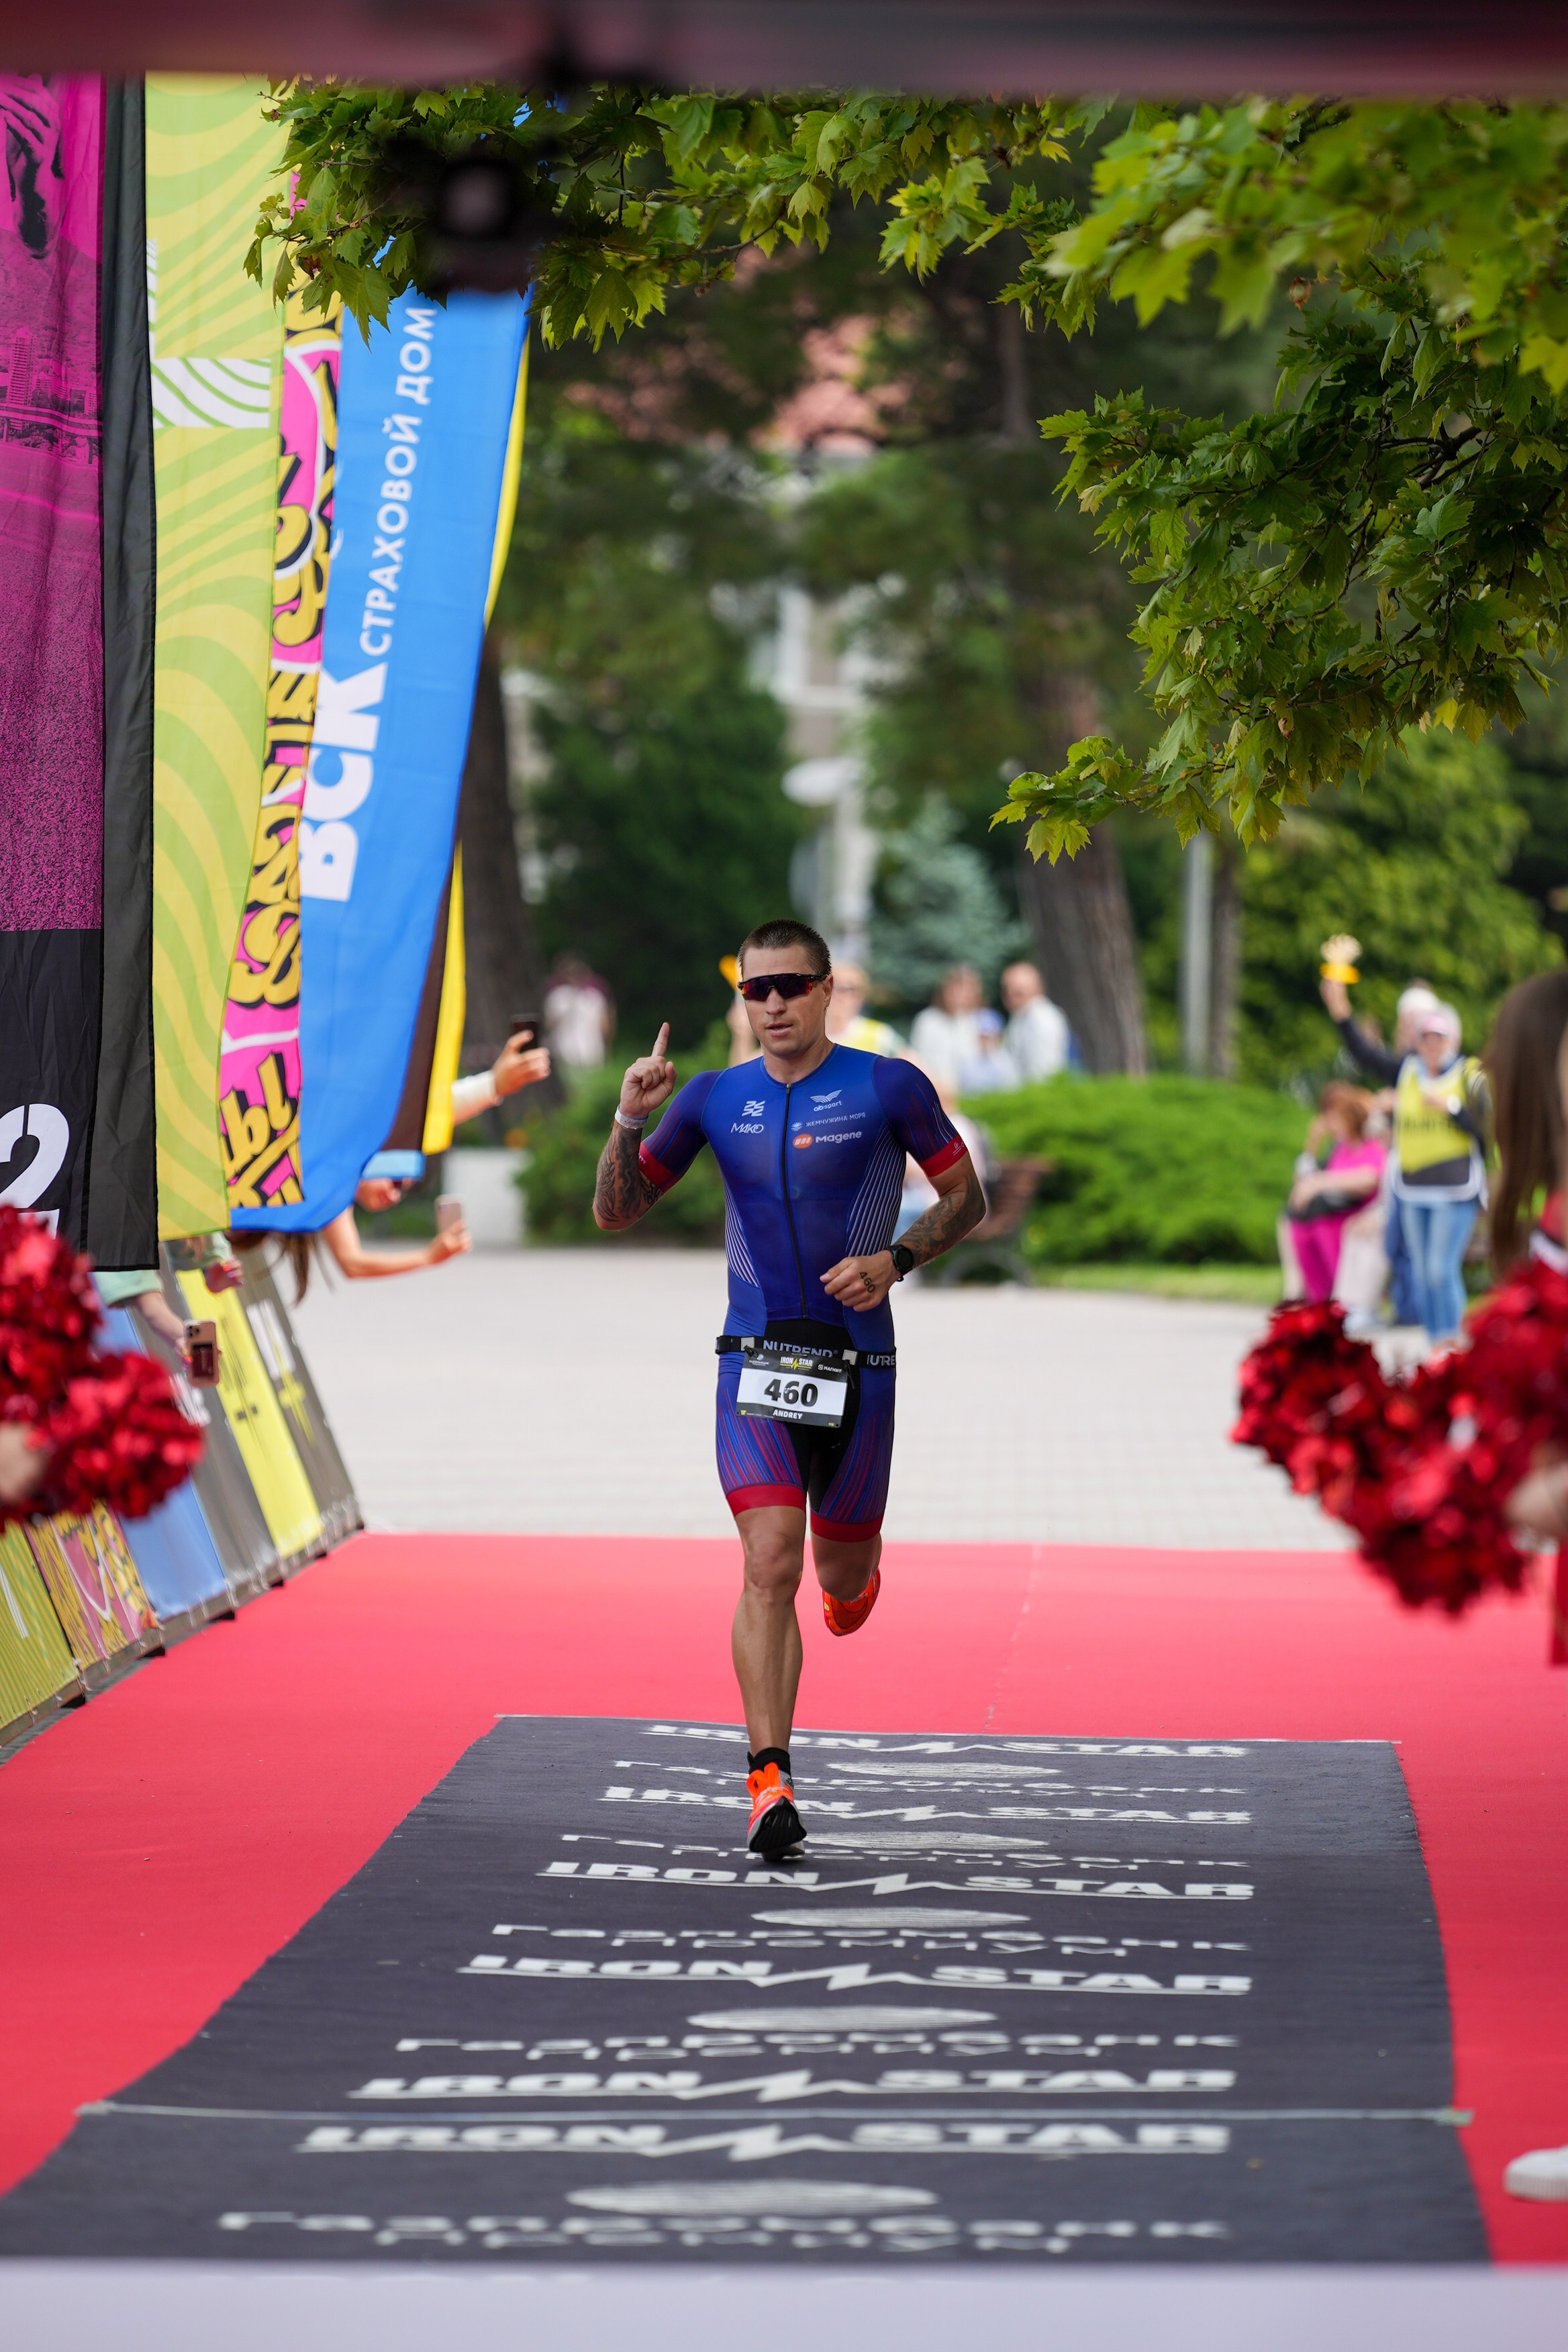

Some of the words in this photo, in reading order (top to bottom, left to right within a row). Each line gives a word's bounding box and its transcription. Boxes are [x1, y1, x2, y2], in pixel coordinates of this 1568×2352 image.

[301, 662, 390, 901] ВСК
[359, 413, 423, 657] СТРАХОВОЙ
[395, 307, 438, 406] ДОМ
[730, 1122, 764, 1134] MAKO
[805, 1115, 848, 1128] ЖЕМЧУЖИНА
[849, 1112, 866, 1120] МОРЯ
[815, 1130, 863, 1144] Magene
[859, 1271, 875, 1293] 460
[780, 1356, 793, 1365] IRON
[798, 1358, 813, 1367] STAR
[867, 1354, 895, 1366] UTRE
[823, 1365, 842, 1373] МАГНИТ
[764, 1379, 818, 1408] 460
[773, 1409, 803, 1420] ANDREY
[1002, 1741, 1248, 1755] STAR
[987, 1806, 1252, 1822] STAR
[544, 1861, 819, 1885] IRON
[965, 1875, 1255, 1896] STAR
[468, 1954, 773, 1977] IRON
[932, 1965, 1253, 1992] STAR
[361, 2070, 701, 2095] IRON
[875, 2069, 1236, 2089] STAR
[302, 2123, 666, 2147] IRON
[851, 2122, 1230, 2148] STAR
